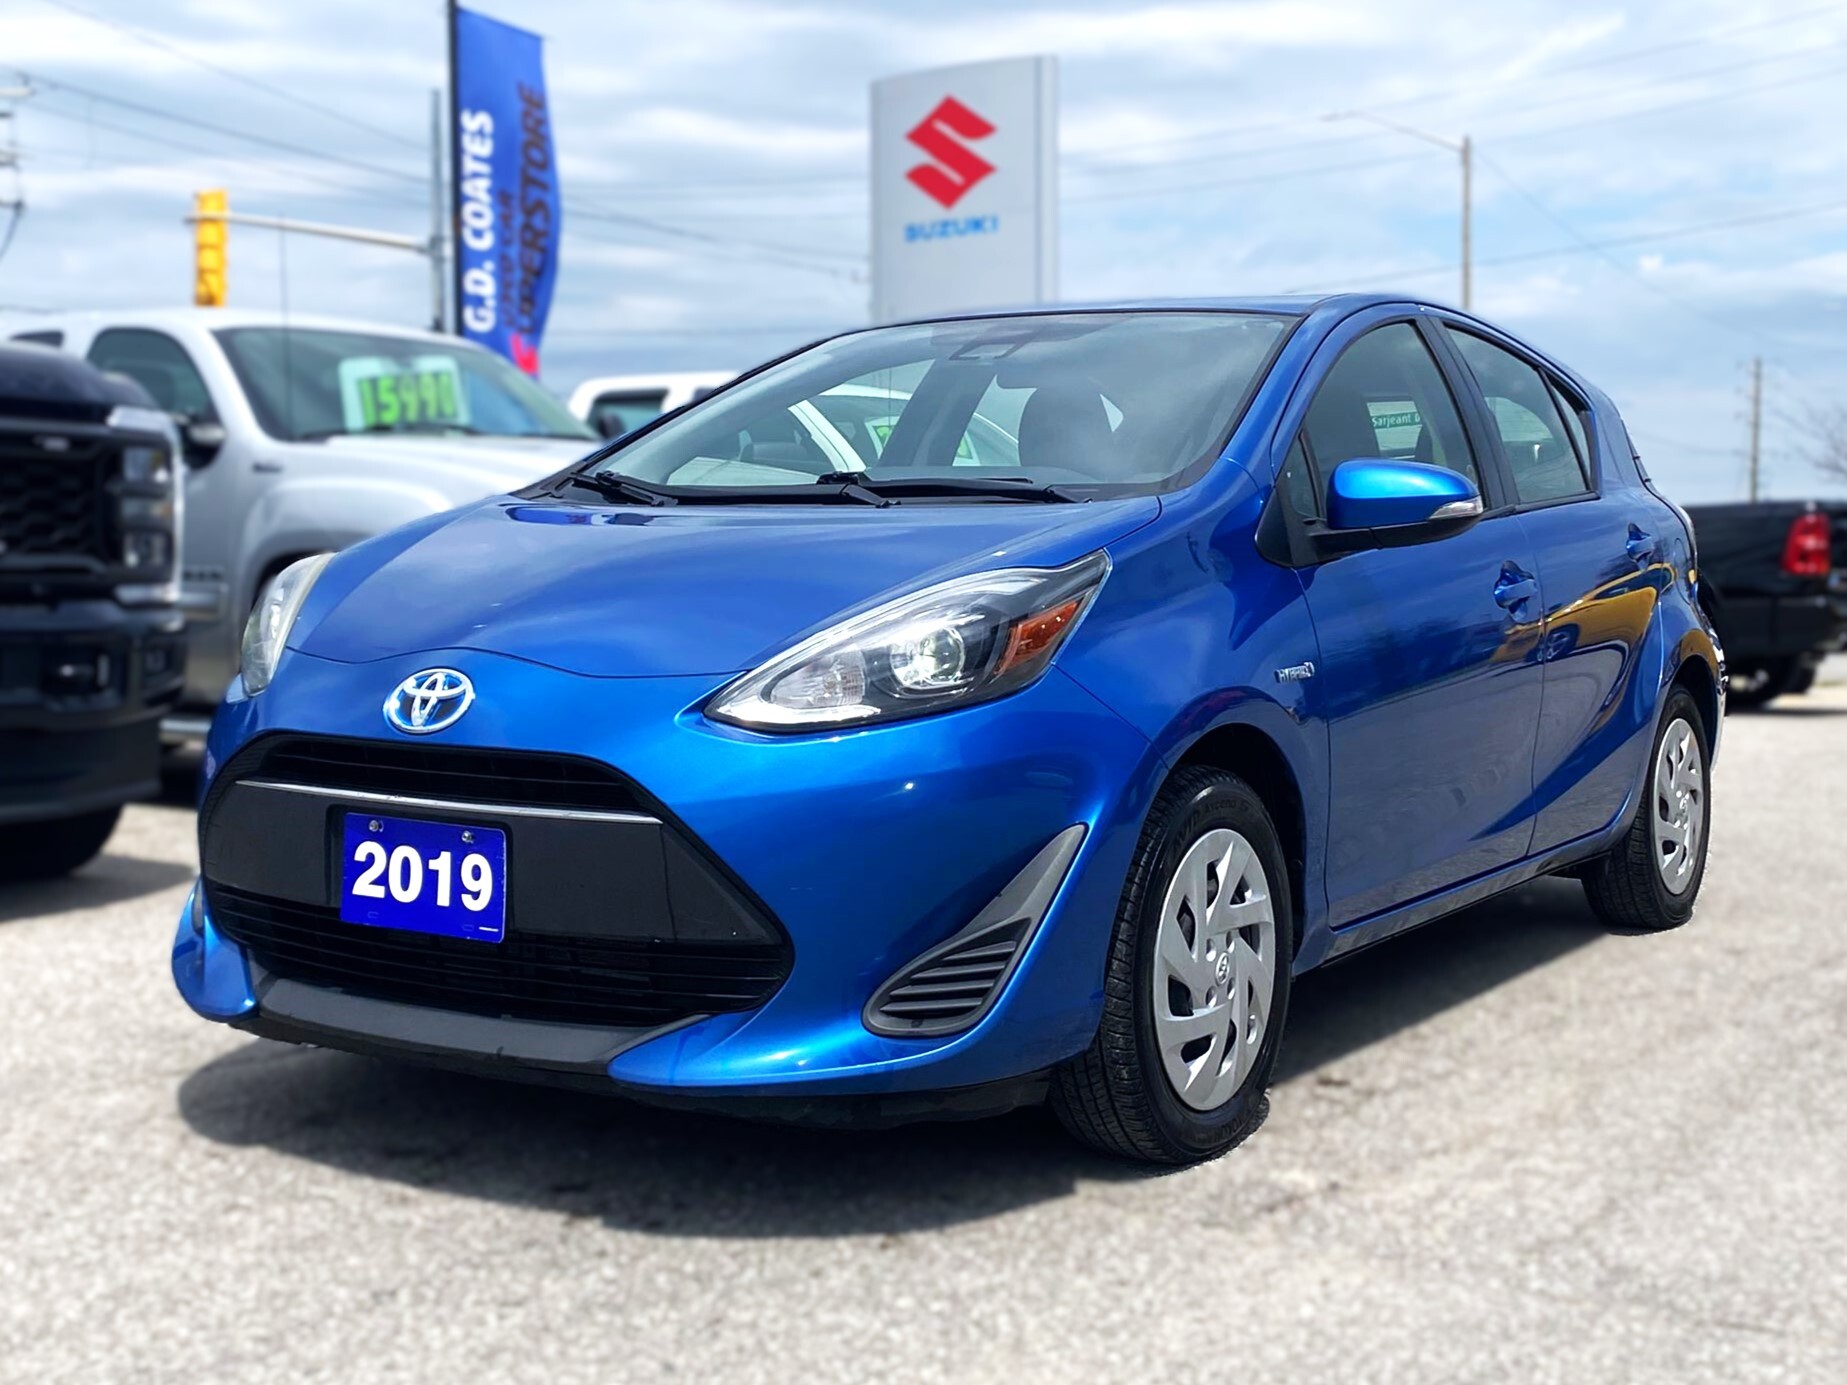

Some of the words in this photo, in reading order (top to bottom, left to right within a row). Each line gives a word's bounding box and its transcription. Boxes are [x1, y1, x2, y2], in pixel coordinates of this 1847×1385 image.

[460, 108, 495, 251] COATES
[904, 214, 998, 243] SUZUKI
[462, 259, 496, 333] G.D.
[1372, 413, 1411, 428] Sarjeant
[352, 840, 493, 912] 2019
